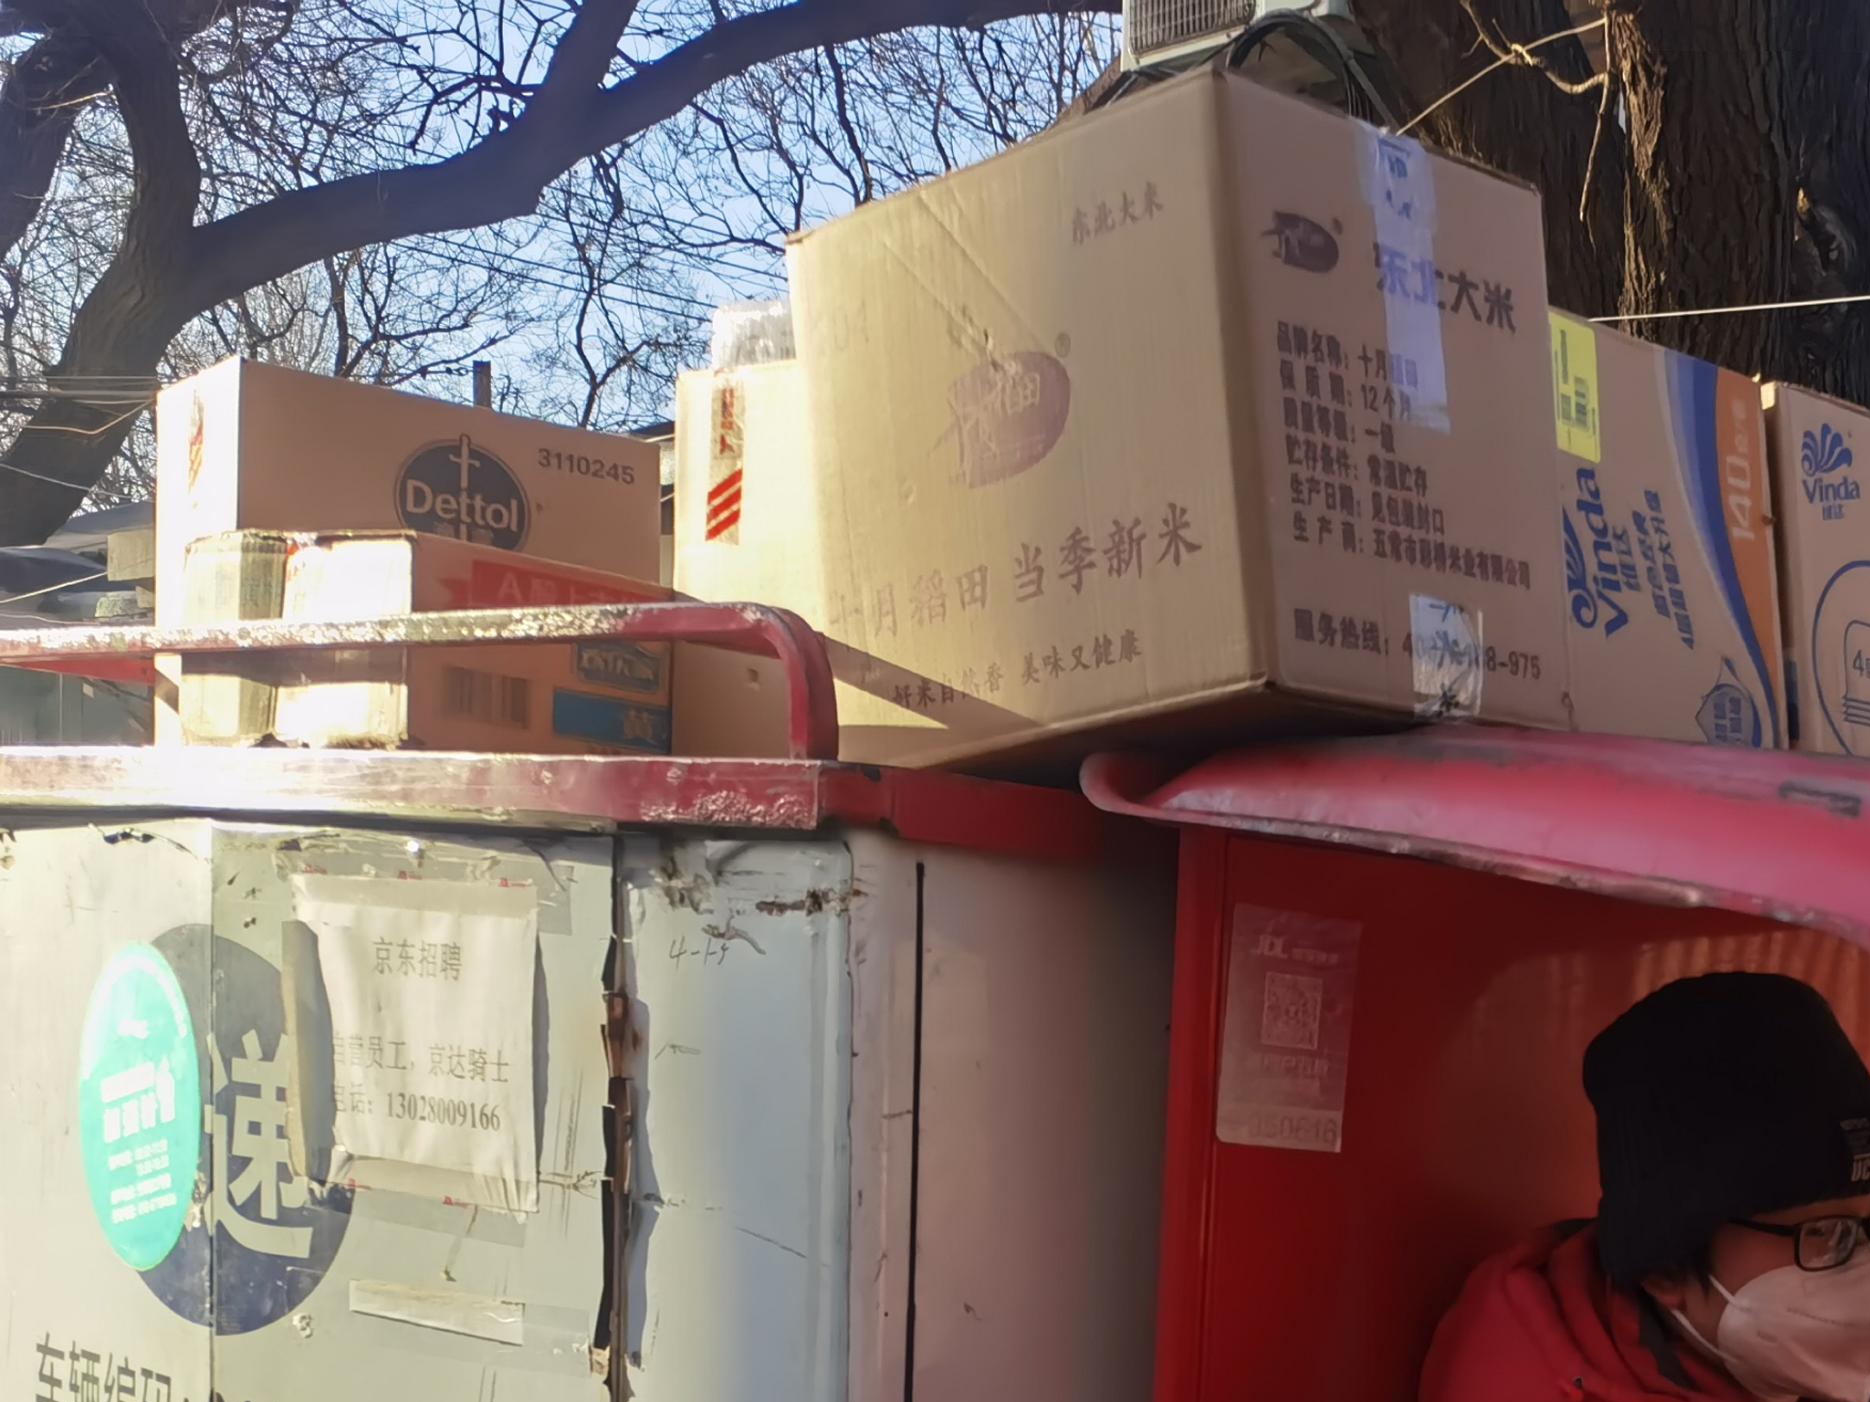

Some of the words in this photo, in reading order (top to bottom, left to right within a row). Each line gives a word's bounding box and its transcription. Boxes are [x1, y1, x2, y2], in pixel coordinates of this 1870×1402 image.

[538, 447, 636, 485] 3110245
[1802, 476, 1861, 504] Vinda
[405, 478, 519, 533] Dettol
[1014, 502, 1203, 603] 当季新米
[1576, 467, 1629, 638] Vinda
[372, 936, 463, 982] 京东招聘
